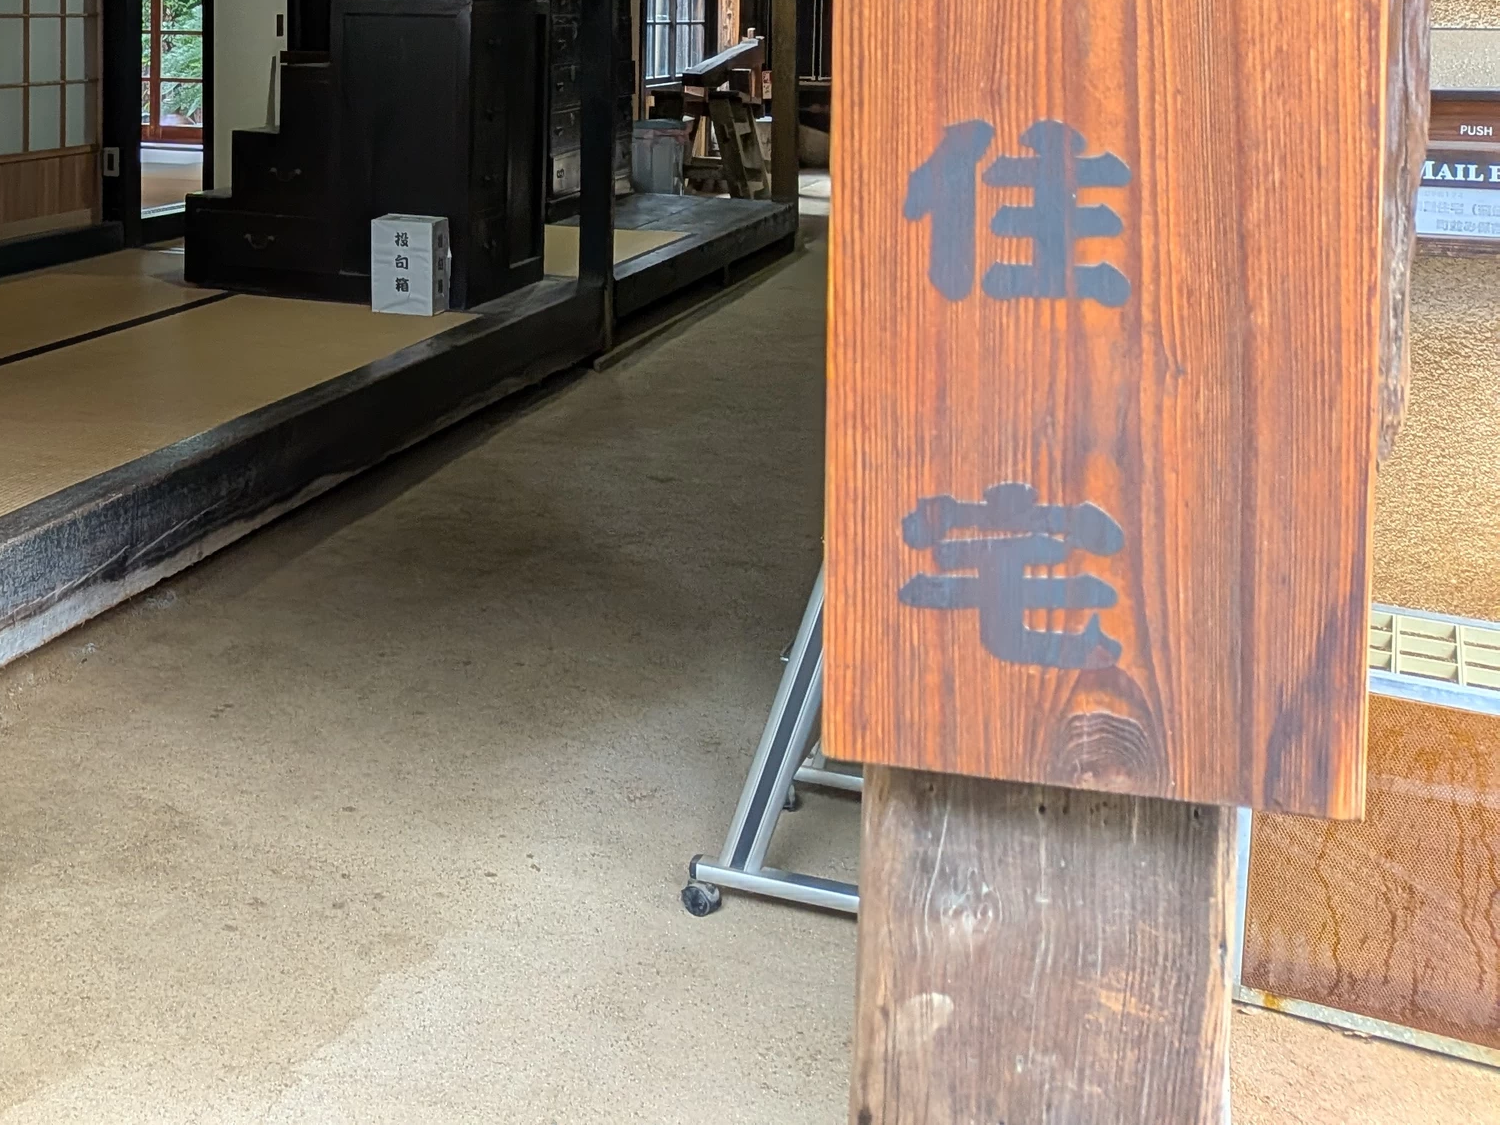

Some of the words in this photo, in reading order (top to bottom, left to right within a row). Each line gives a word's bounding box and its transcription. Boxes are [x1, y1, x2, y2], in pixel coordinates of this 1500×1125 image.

[1460, 125, 1493, 136] PUSH
[395, 231, 409, 293] 投句箱
